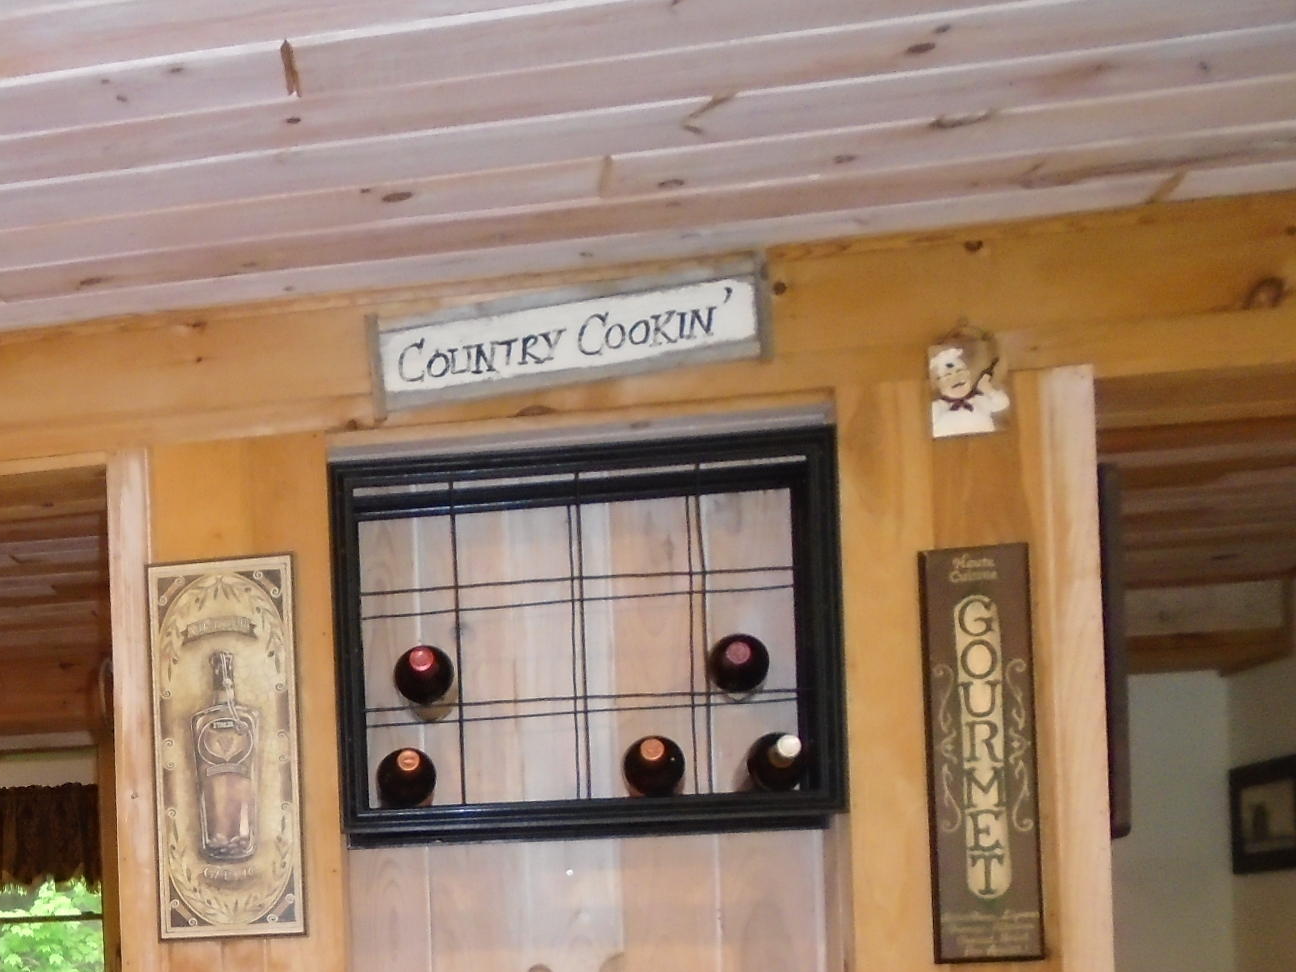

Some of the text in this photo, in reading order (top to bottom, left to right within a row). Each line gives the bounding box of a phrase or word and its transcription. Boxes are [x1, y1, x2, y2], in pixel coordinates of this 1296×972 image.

[398, 287, 733, 383] COUNTRY COOKIN'
[958, 598, 1004, 896] GOURMET
